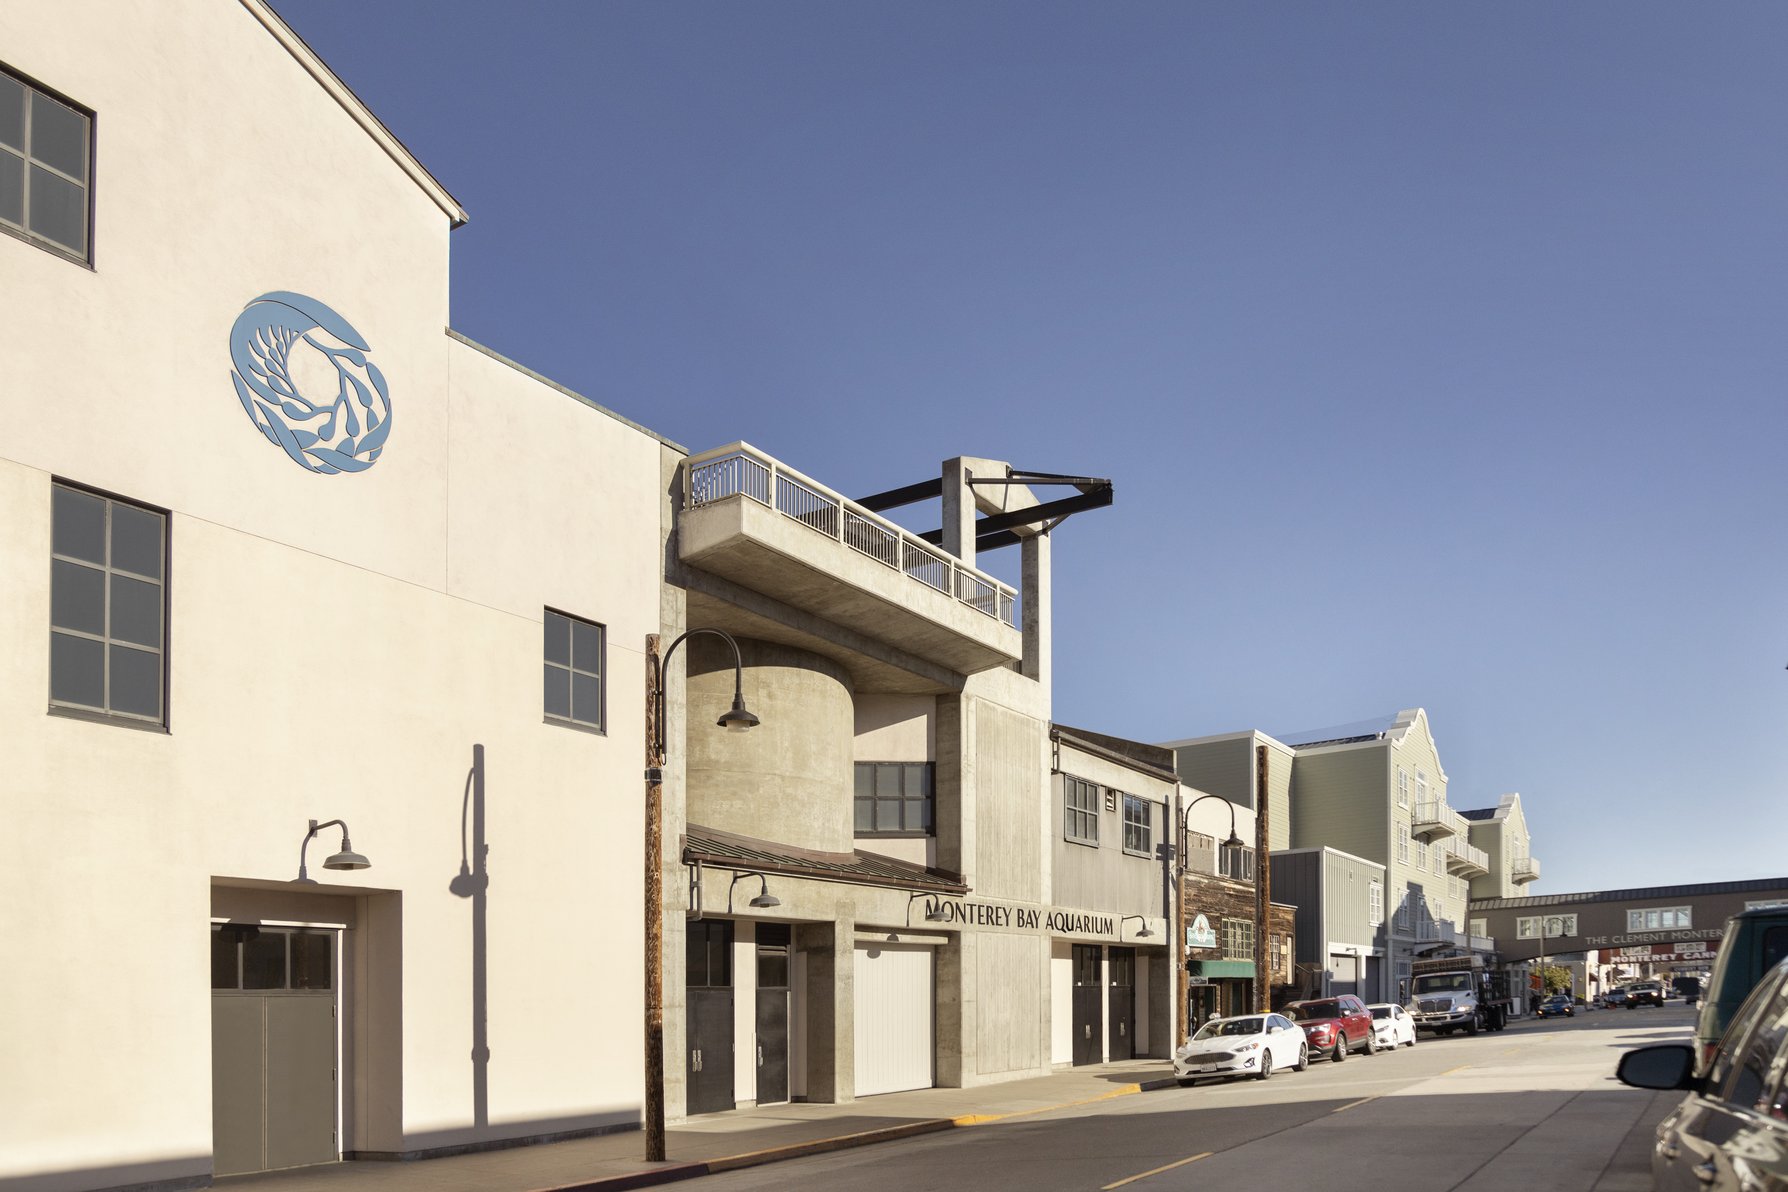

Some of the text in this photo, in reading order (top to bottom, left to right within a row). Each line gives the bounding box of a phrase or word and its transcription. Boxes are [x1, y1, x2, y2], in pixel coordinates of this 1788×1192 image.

[925, 899, 1113, 935] MONTEREY BAY AQUARIUM
[1585, 936, 1607, 945] THE
[1612, 932, 1666, 944] CLEMENT
[1610, 953, 1676, 963] MONTEREY
